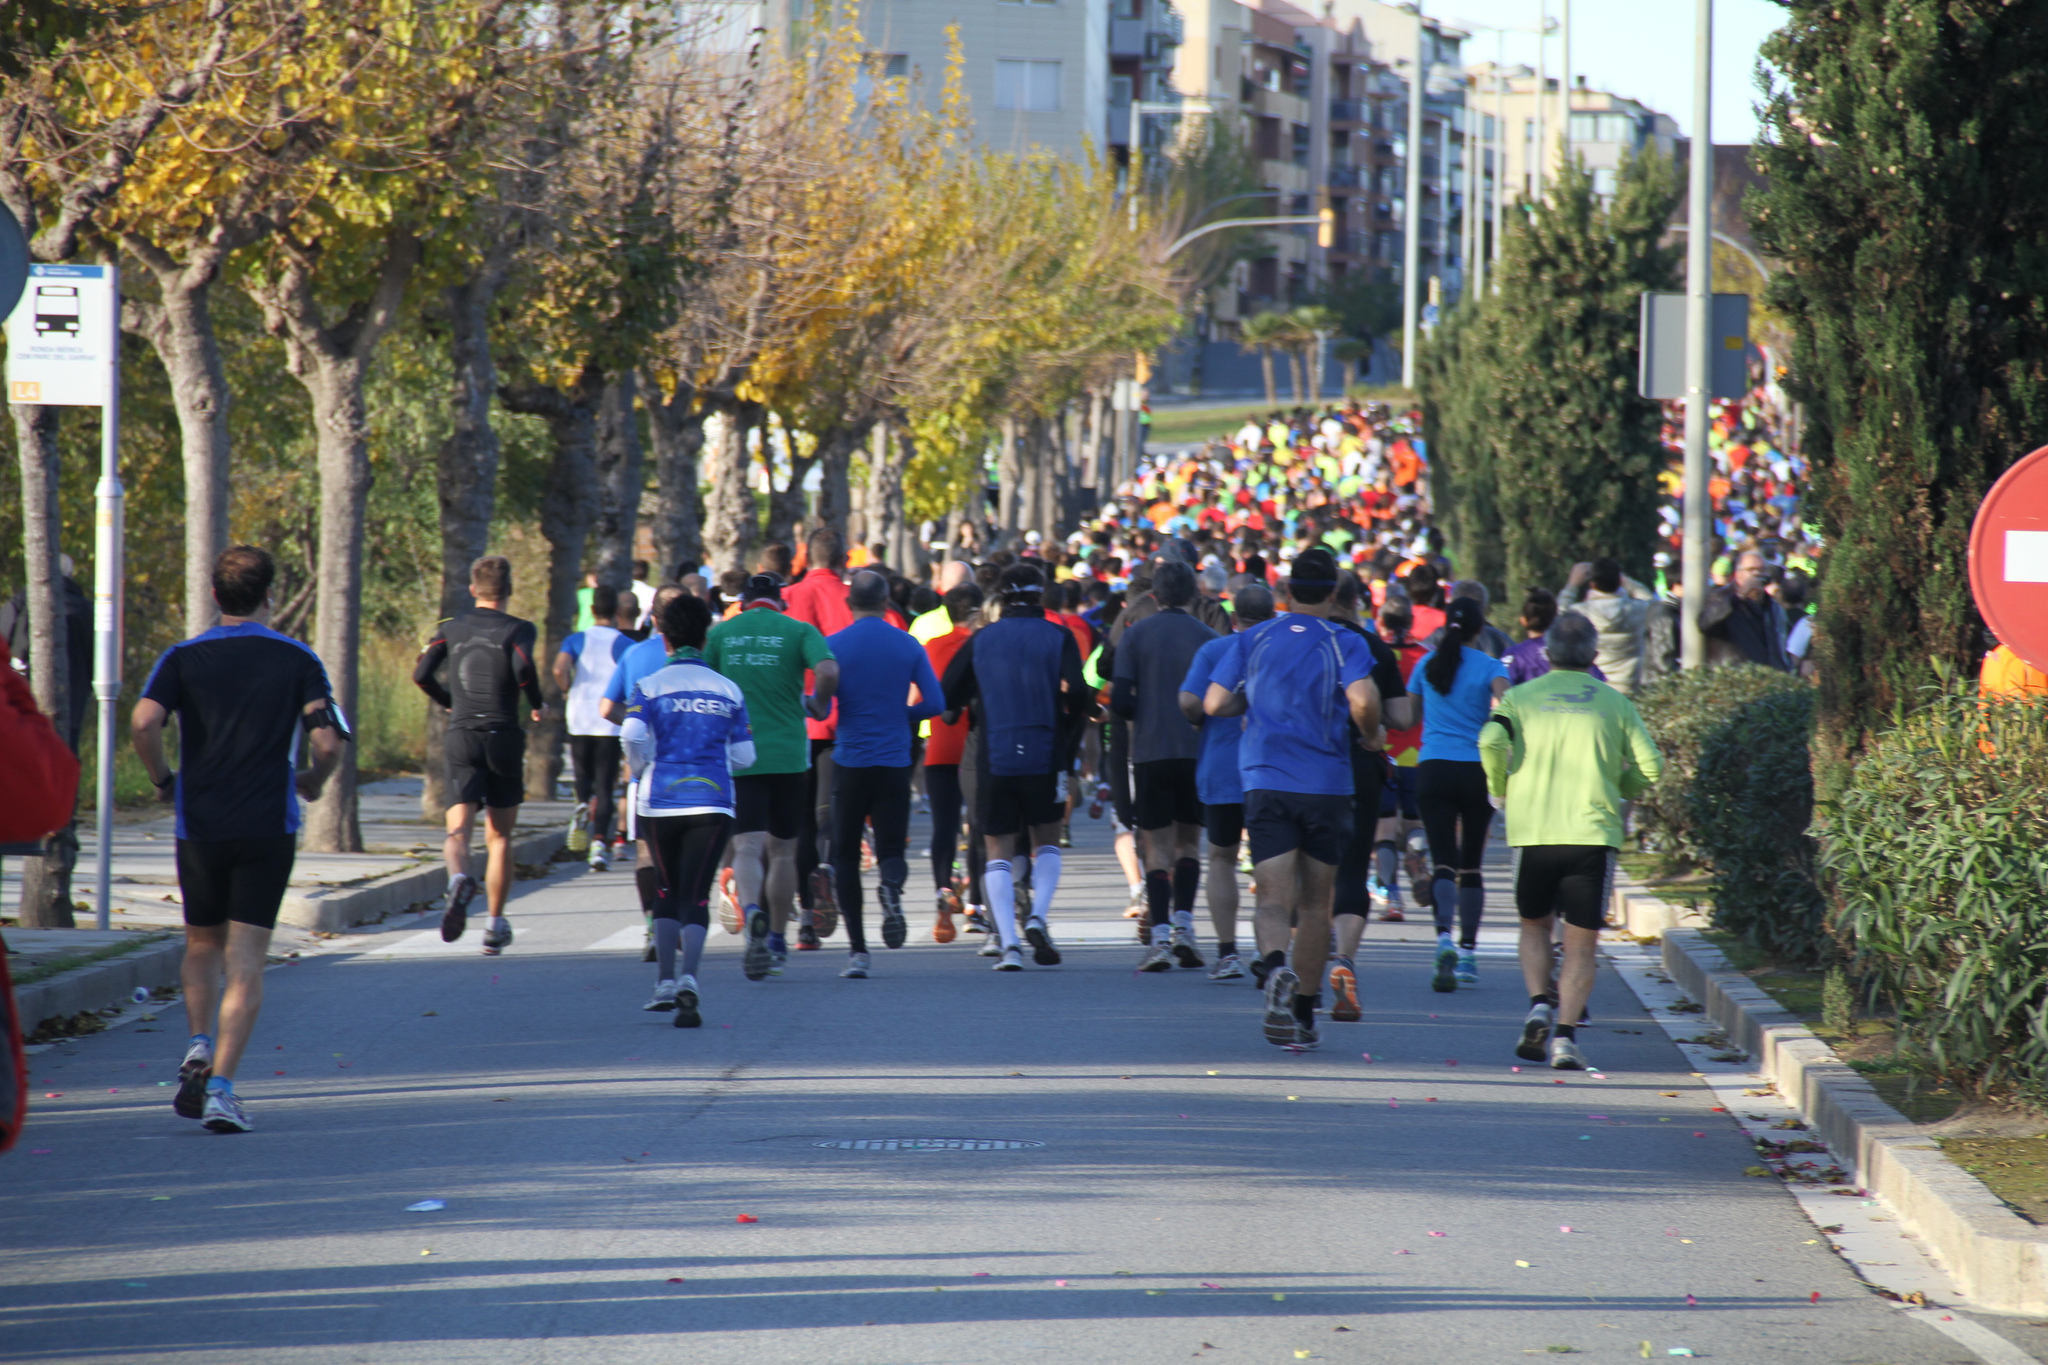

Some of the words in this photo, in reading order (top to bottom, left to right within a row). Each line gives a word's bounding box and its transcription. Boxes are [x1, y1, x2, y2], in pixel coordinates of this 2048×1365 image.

[15, 384, 38, 398] L4
[756, 636, 784, 648] PERE
[727, 654, 743, 666] DE
